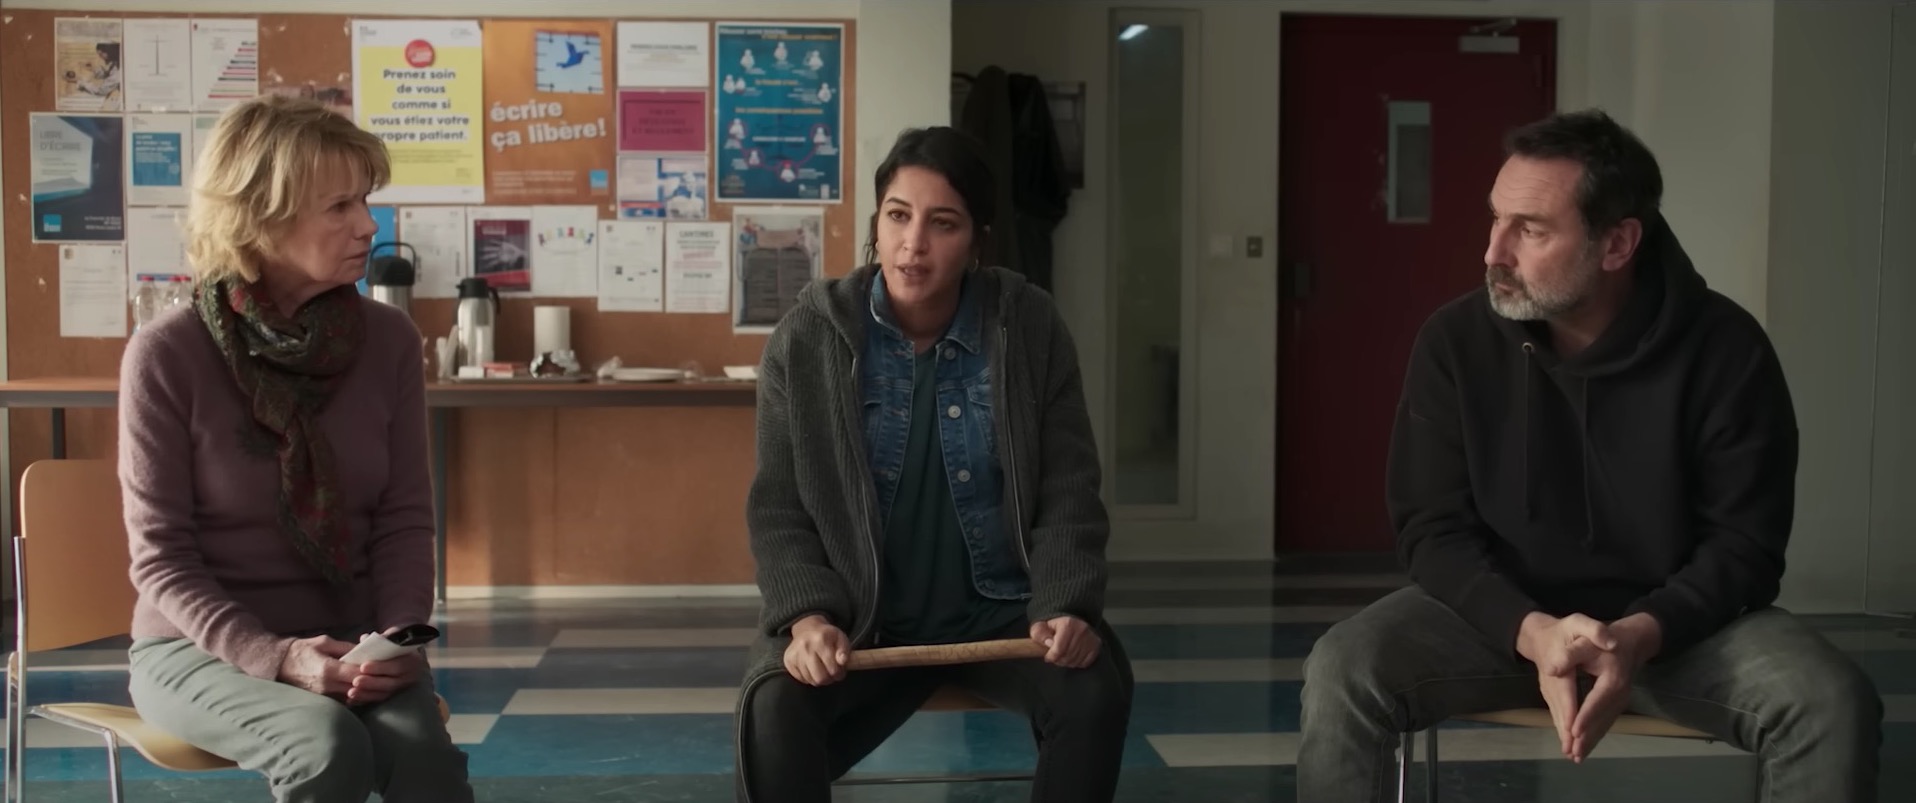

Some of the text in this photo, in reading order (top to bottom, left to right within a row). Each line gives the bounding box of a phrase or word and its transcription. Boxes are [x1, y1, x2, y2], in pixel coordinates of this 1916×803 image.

[383, 69, 456, 79] Prenez soin
[397, 84, 446, 94] de vous
[392, 100, 452, 110] comme si
[490, 101, 563, 122] écrire
[371, 115, 469, 126] vous étiez votre
[419, 131, 467, 142] patient.
[491, 118, 606, 152] ça libère!
